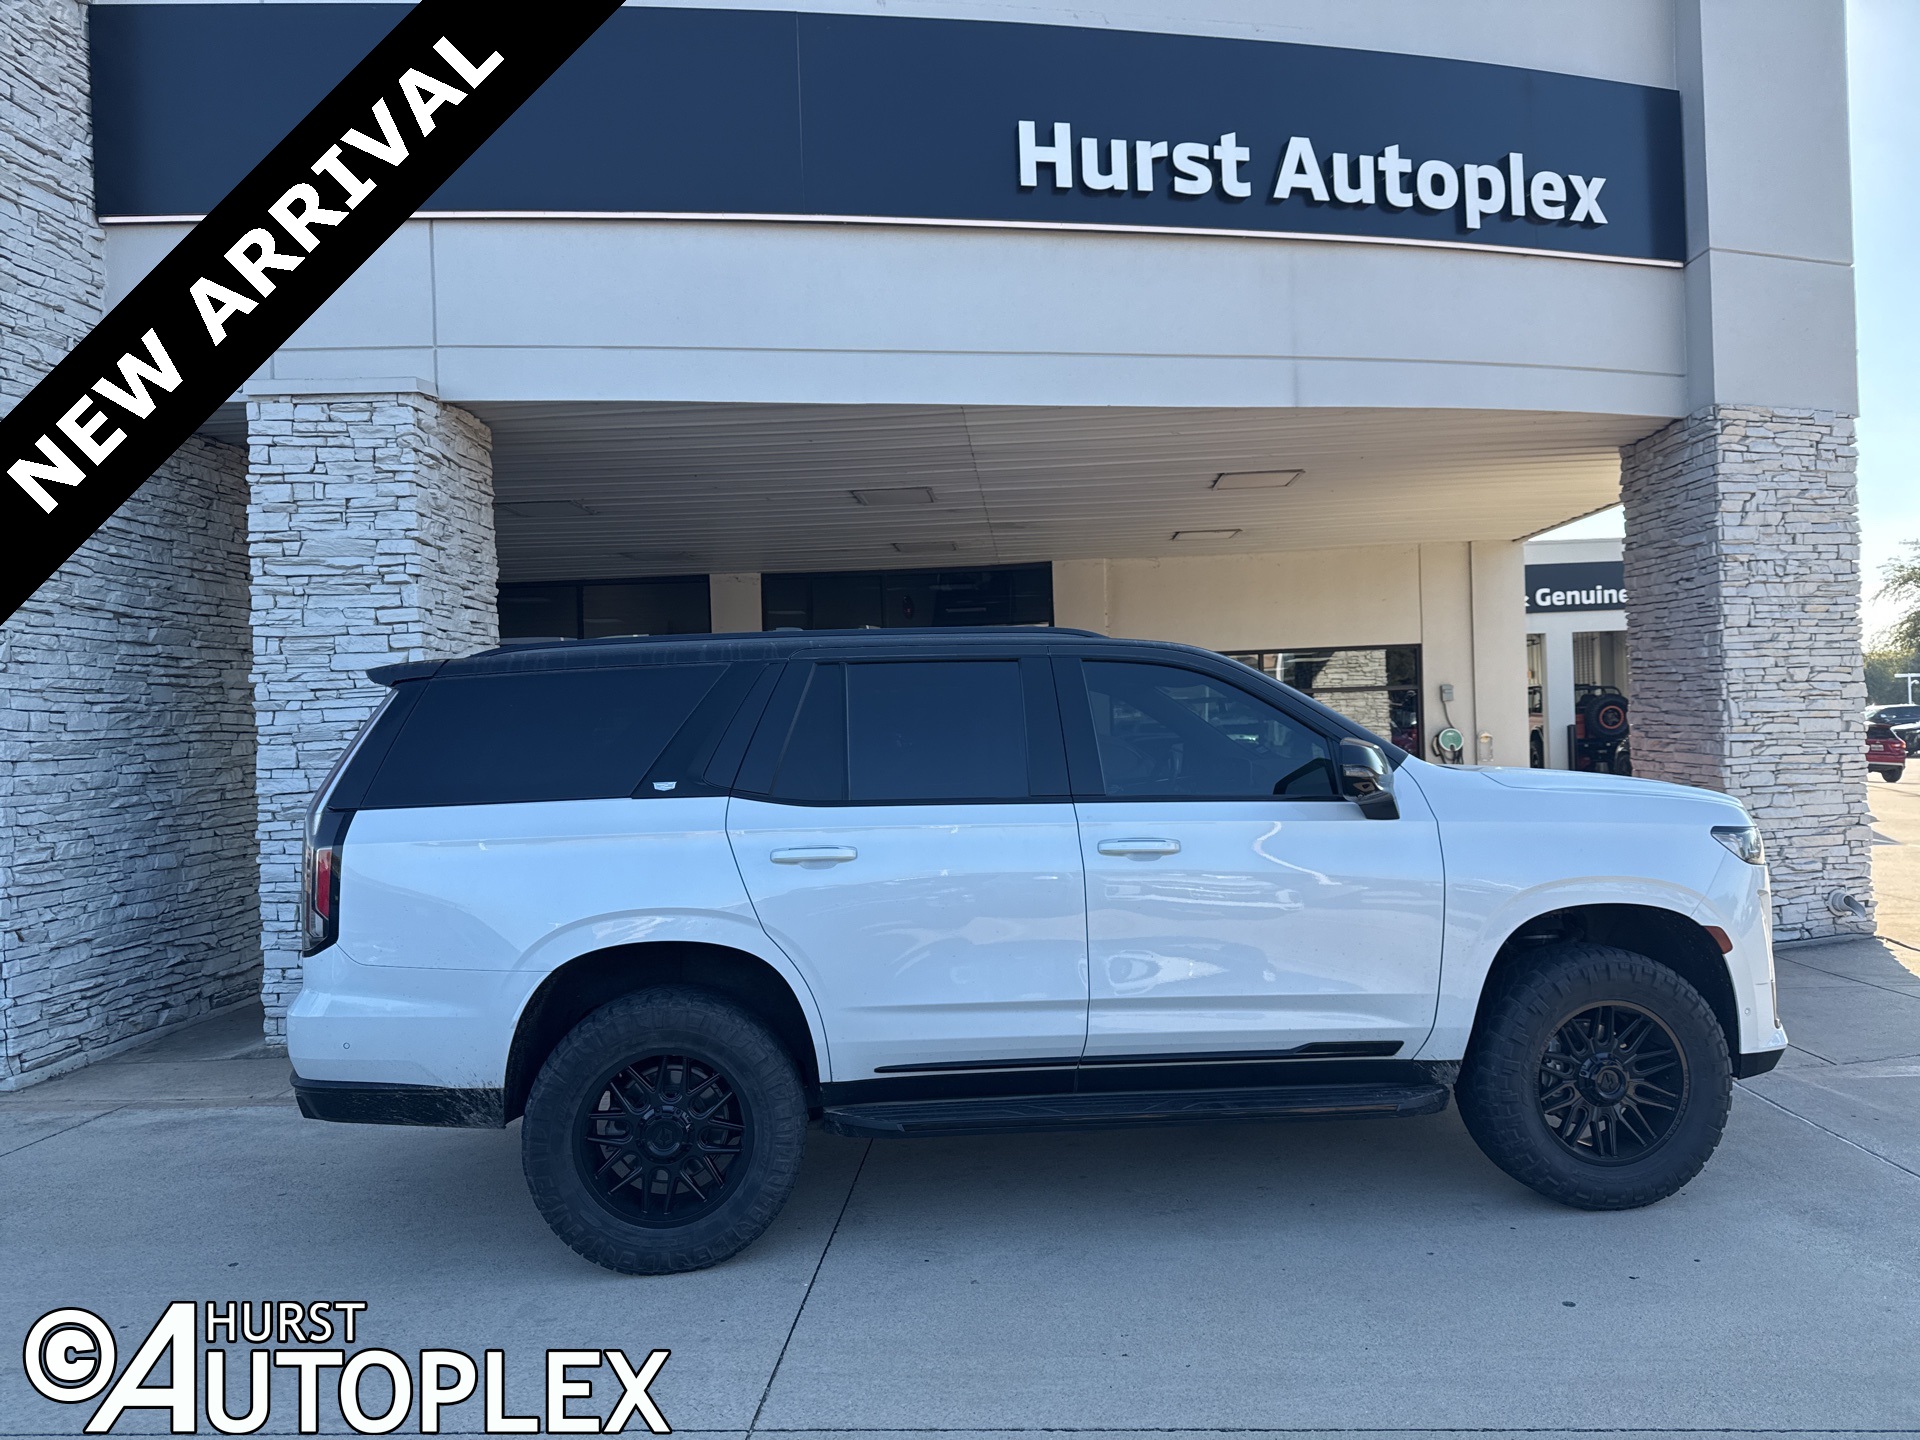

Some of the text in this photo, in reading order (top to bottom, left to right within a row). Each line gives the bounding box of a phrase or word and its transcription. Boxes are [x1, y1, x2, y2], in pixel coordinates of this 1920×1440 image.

[1017, 121, 1609, 229] Hurst Autoplex
[1535, 585, 1629, 606] Genuine
